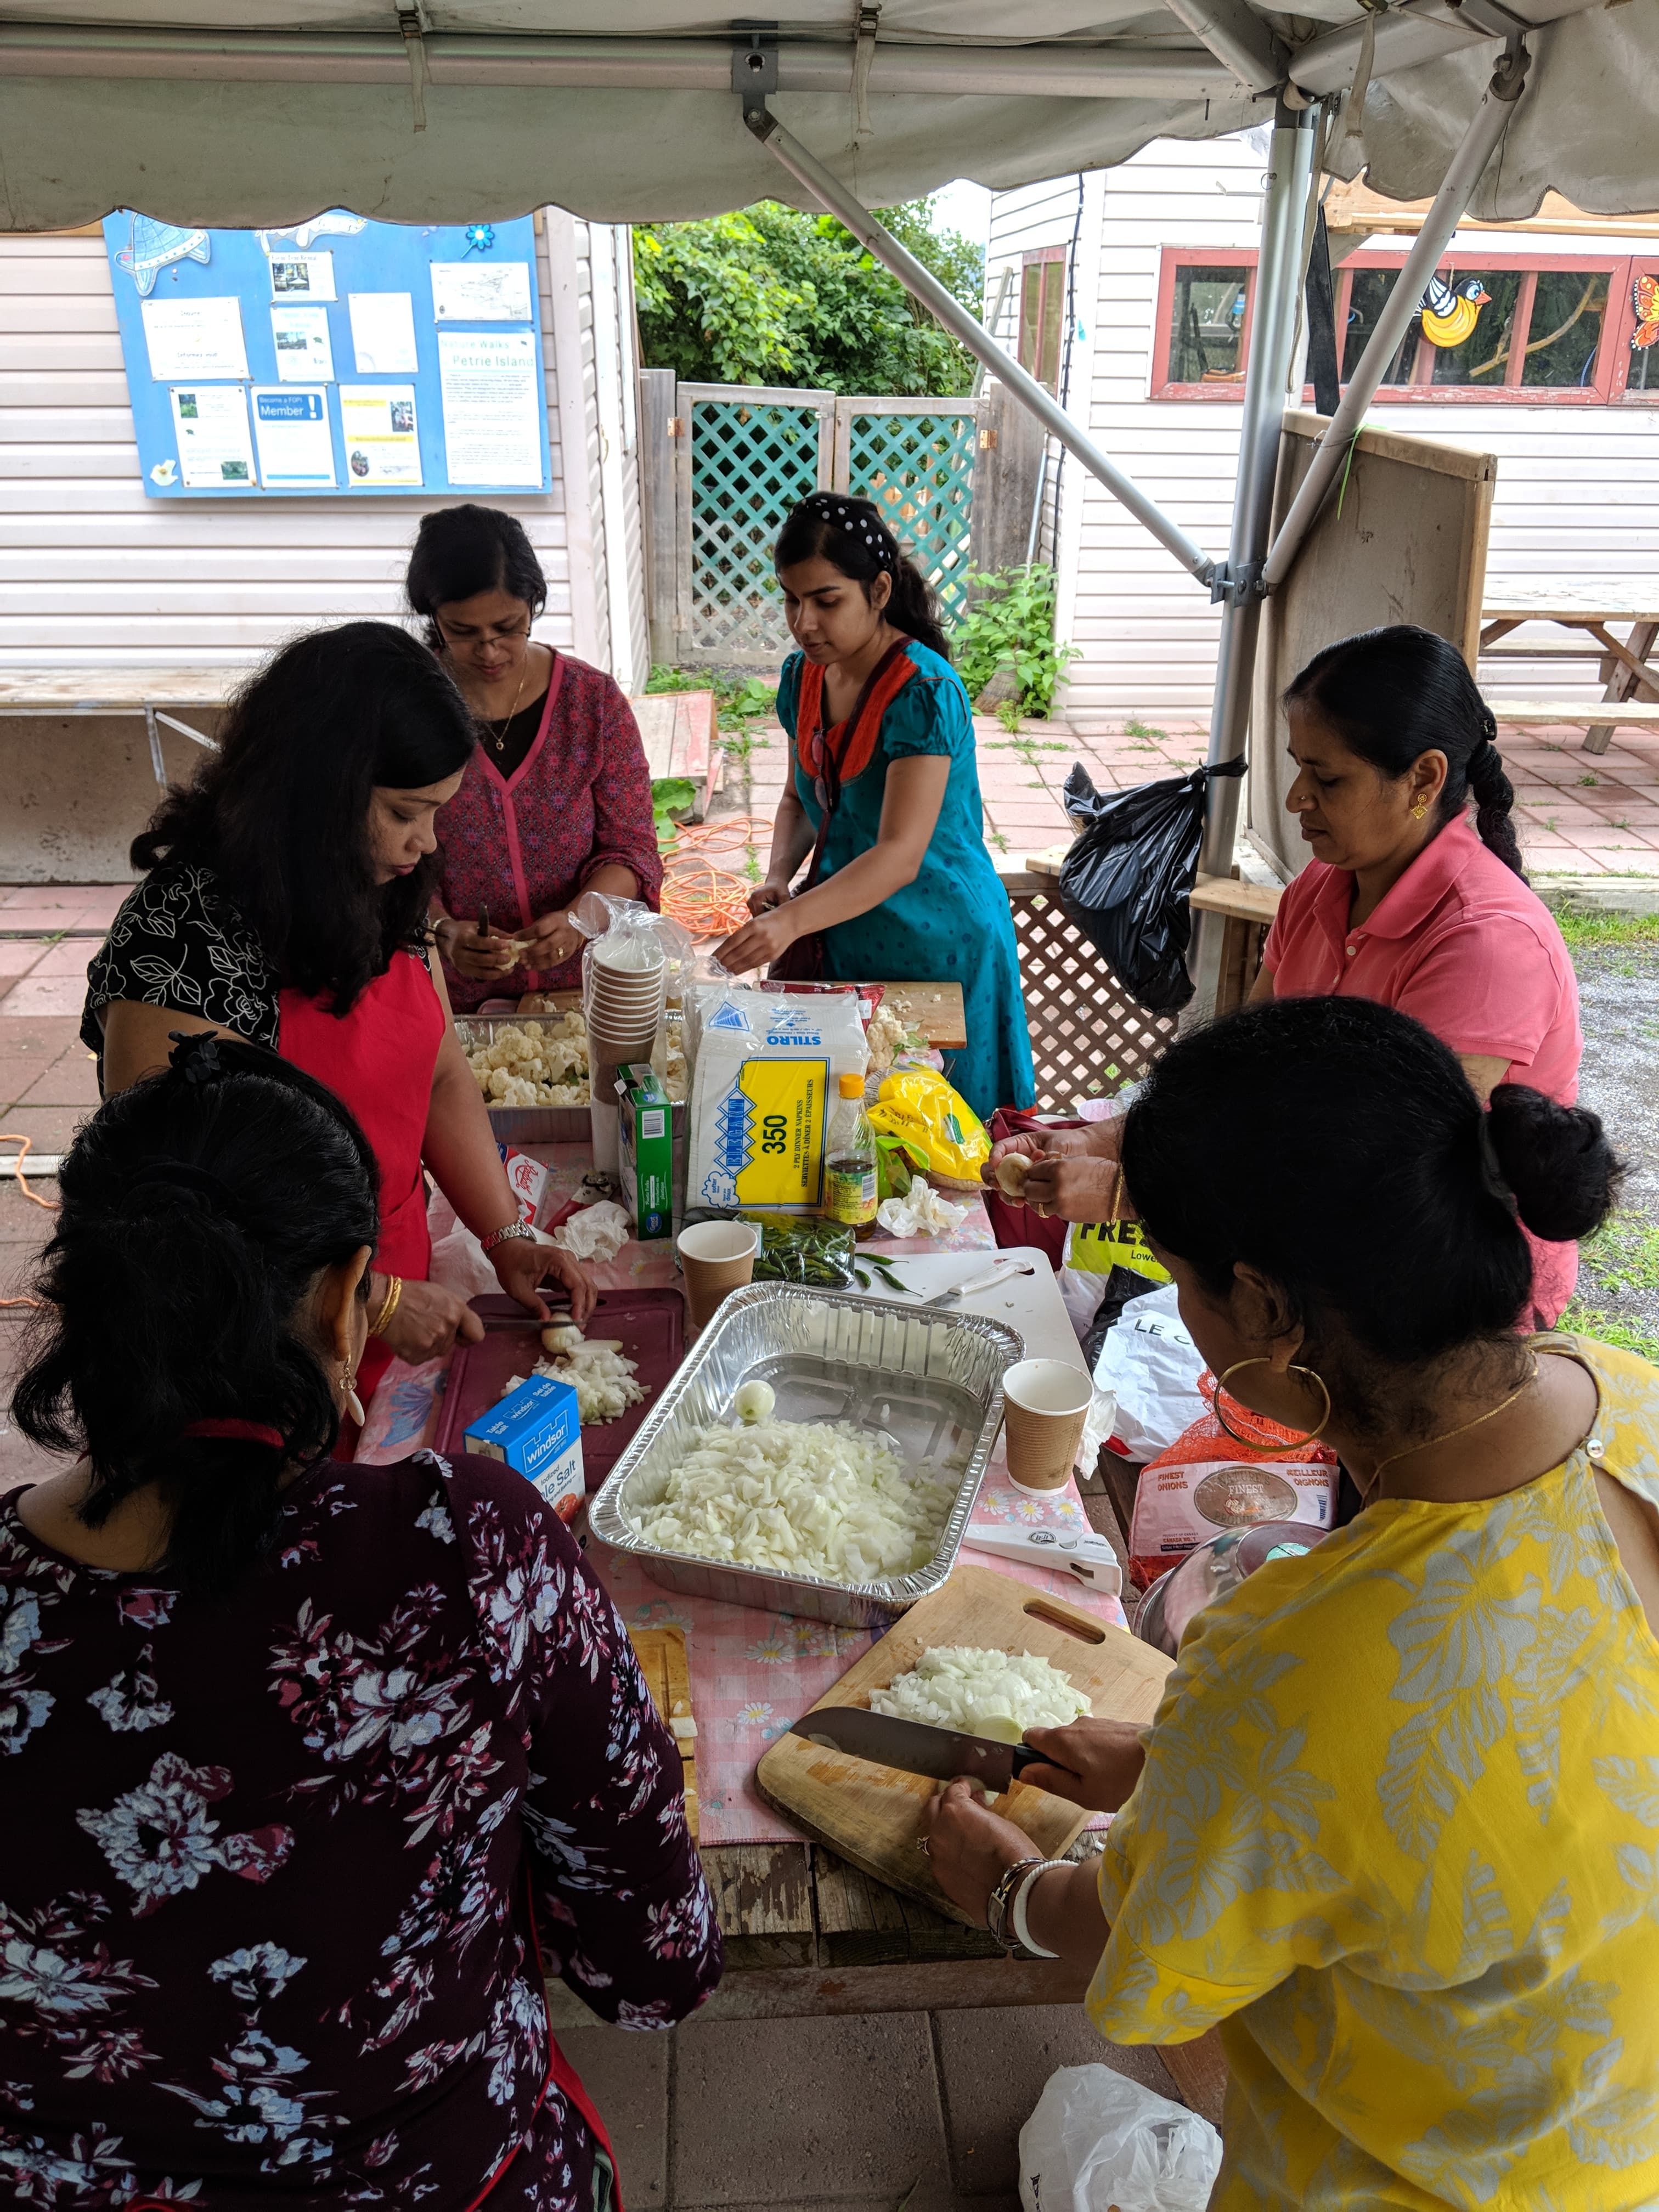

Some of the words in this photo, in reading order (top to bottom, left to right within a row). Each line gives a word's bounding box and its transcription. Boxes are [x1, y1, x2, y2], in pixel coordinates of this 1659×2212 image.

[480, 340, 509, 348] Walks
[453, 356, 491, 366] Petrie
[495, 356, 534, 366] Island
[261, 405, 303, 415] Member
[767, 1036, 821, 1046] STILRO
[805, 1079, 814, 1118] ÉPAISSEURS
[727, 1099, 744, 1165] ELEGANT
[762, 1115, 787, 1154] 350
[1135, 1318, 1165, 1336] LE
[532, 1387, 543, 1397] Sel
[543, 1382, 551, 1390] de
[540, 1386, 556, 1397] table
[511, 1400, 534, 1419] windsor
[486, 1421, 504, 1434] Table
[495, 1425, 509, 1435] Salt
[527, 1424, 566, 1464] windsor
[556, 1459, 576, 1486] Salt
[1158, 1471, 1184, 1481] FINEST
[1158, 1482, 1188, 1491] ONIONS
[1228, 1483, 1264, 1494] FINEST
[1294, 1479, 1329, 1487] OIGNONS
